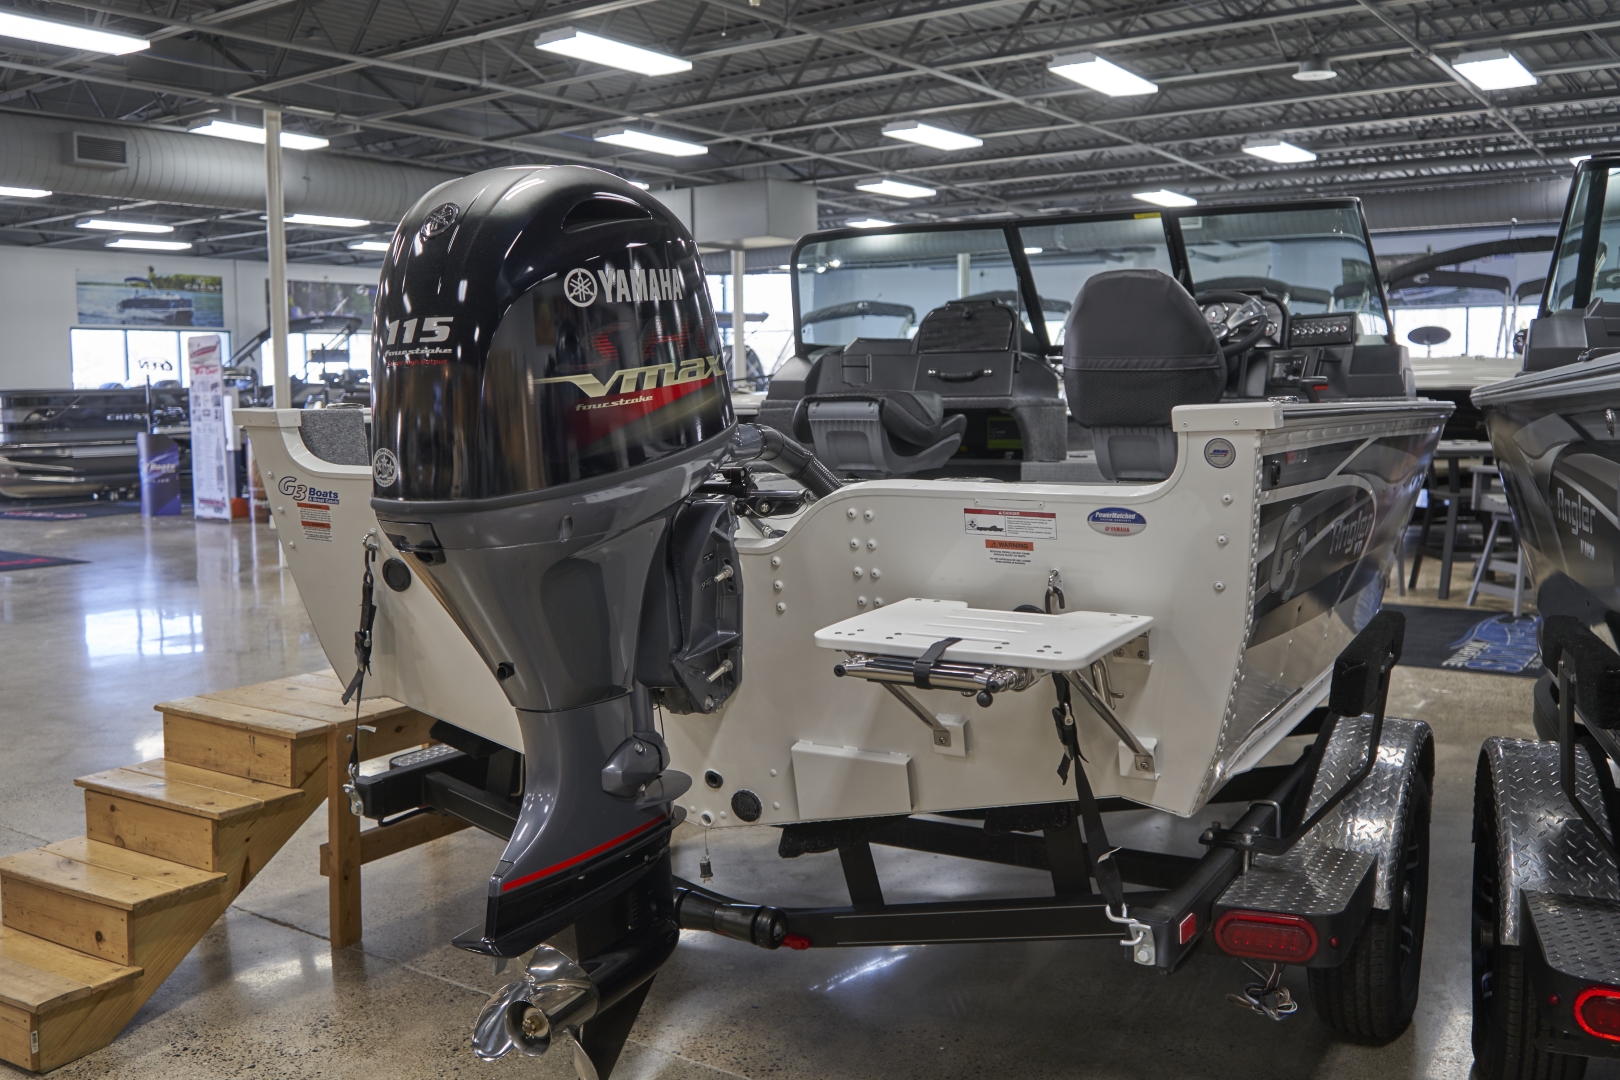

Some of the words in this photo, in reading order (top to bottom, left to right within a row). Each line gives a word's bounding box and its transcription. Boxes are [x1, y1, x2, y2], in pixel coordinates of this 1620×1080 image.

[597, 269, 683, 303] YAMAHA
[386, 317, 454, 345] 115
[278, 476, 307, 501] G3
[308, 487, 339, 499] Boats
[1095, 511, 1136, 520] PowerMatched
[1557, 487, 1596, 536] Angler
[1330, 511, 1373, 554] Angler
[1269, 504, 1307, 603] G3
